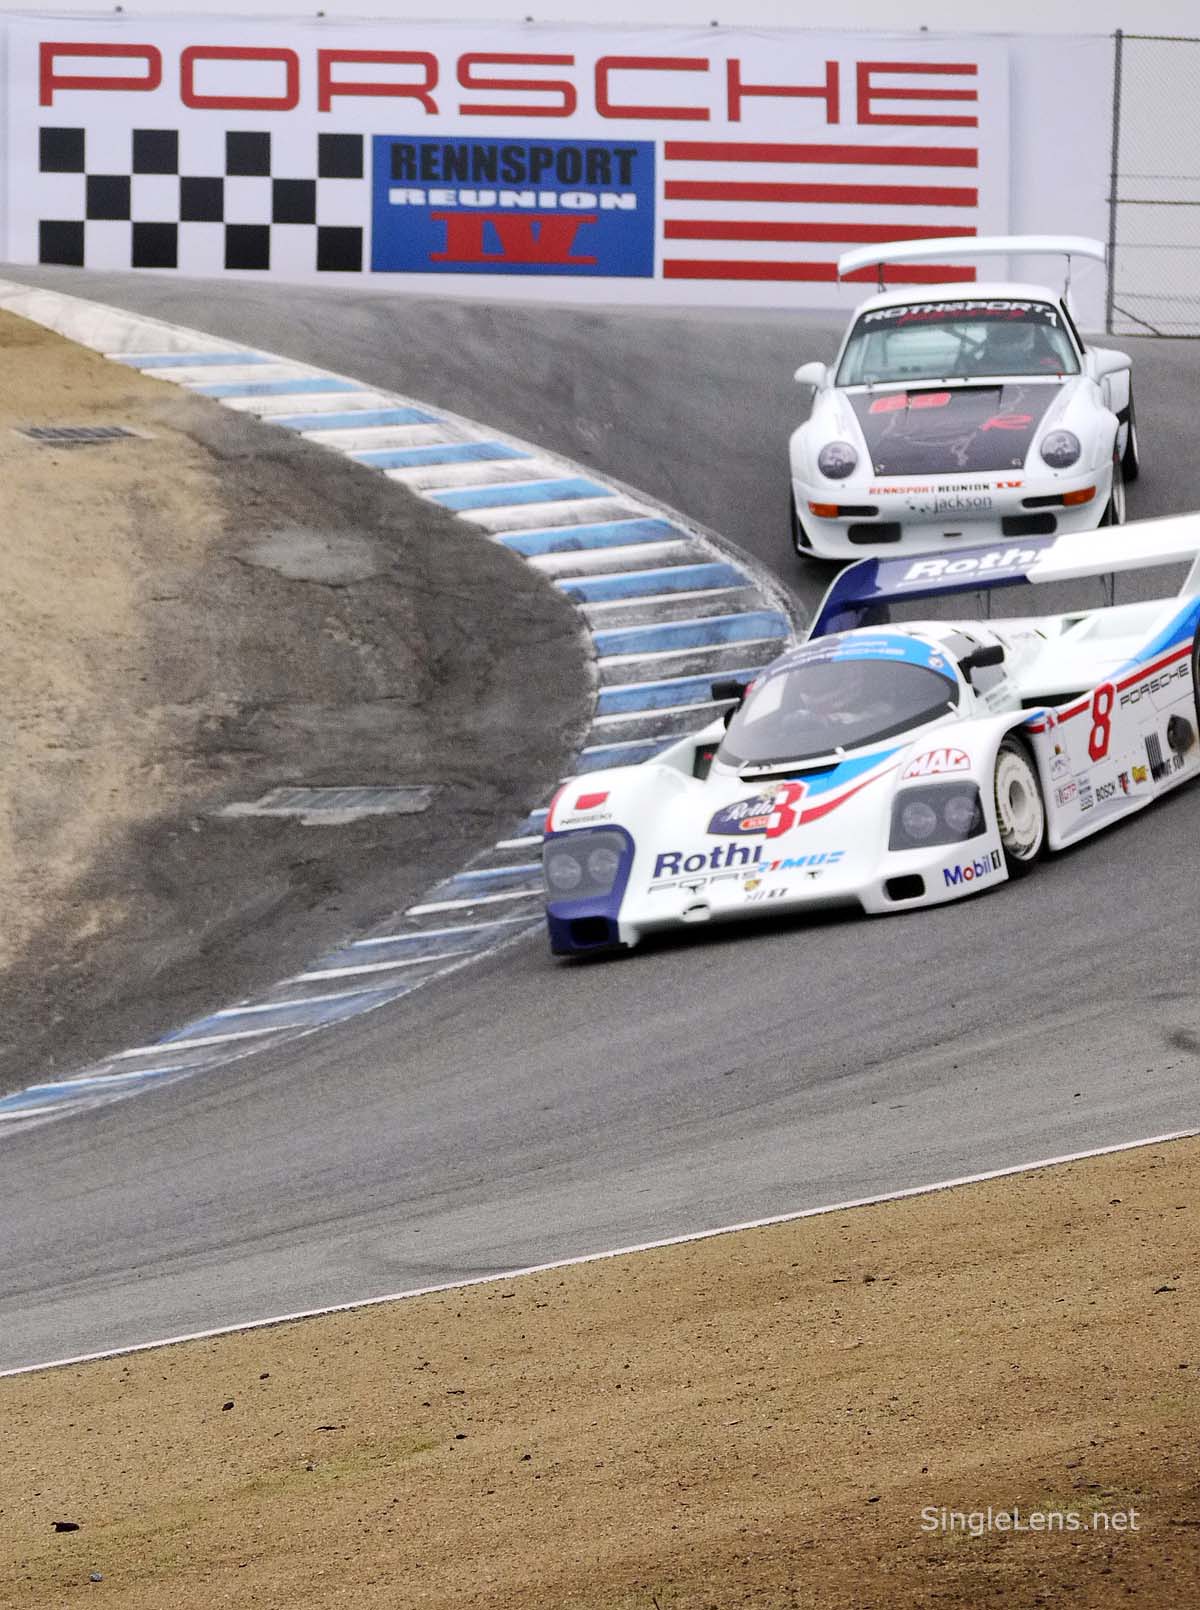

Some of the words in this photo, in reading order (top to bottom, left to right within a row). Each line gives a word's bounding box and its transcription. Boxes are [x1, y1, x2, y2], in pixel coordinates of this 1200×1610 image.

[39, 42, 979, 128] PORSCHE
[389, 142, 638, 186] RENNSPORT
[388, 187, 638, 211] REUNION
[429, 211, 598, 265] IV
[863, 300, 1051, 324] ROTHSPORT
[937, 482, 991, 494] REUNION
[1119, 662, 1190, 710] PORSCHE
[1087, 682, 1115, 763] 8
[943, 854, 991, 887] Mobil
